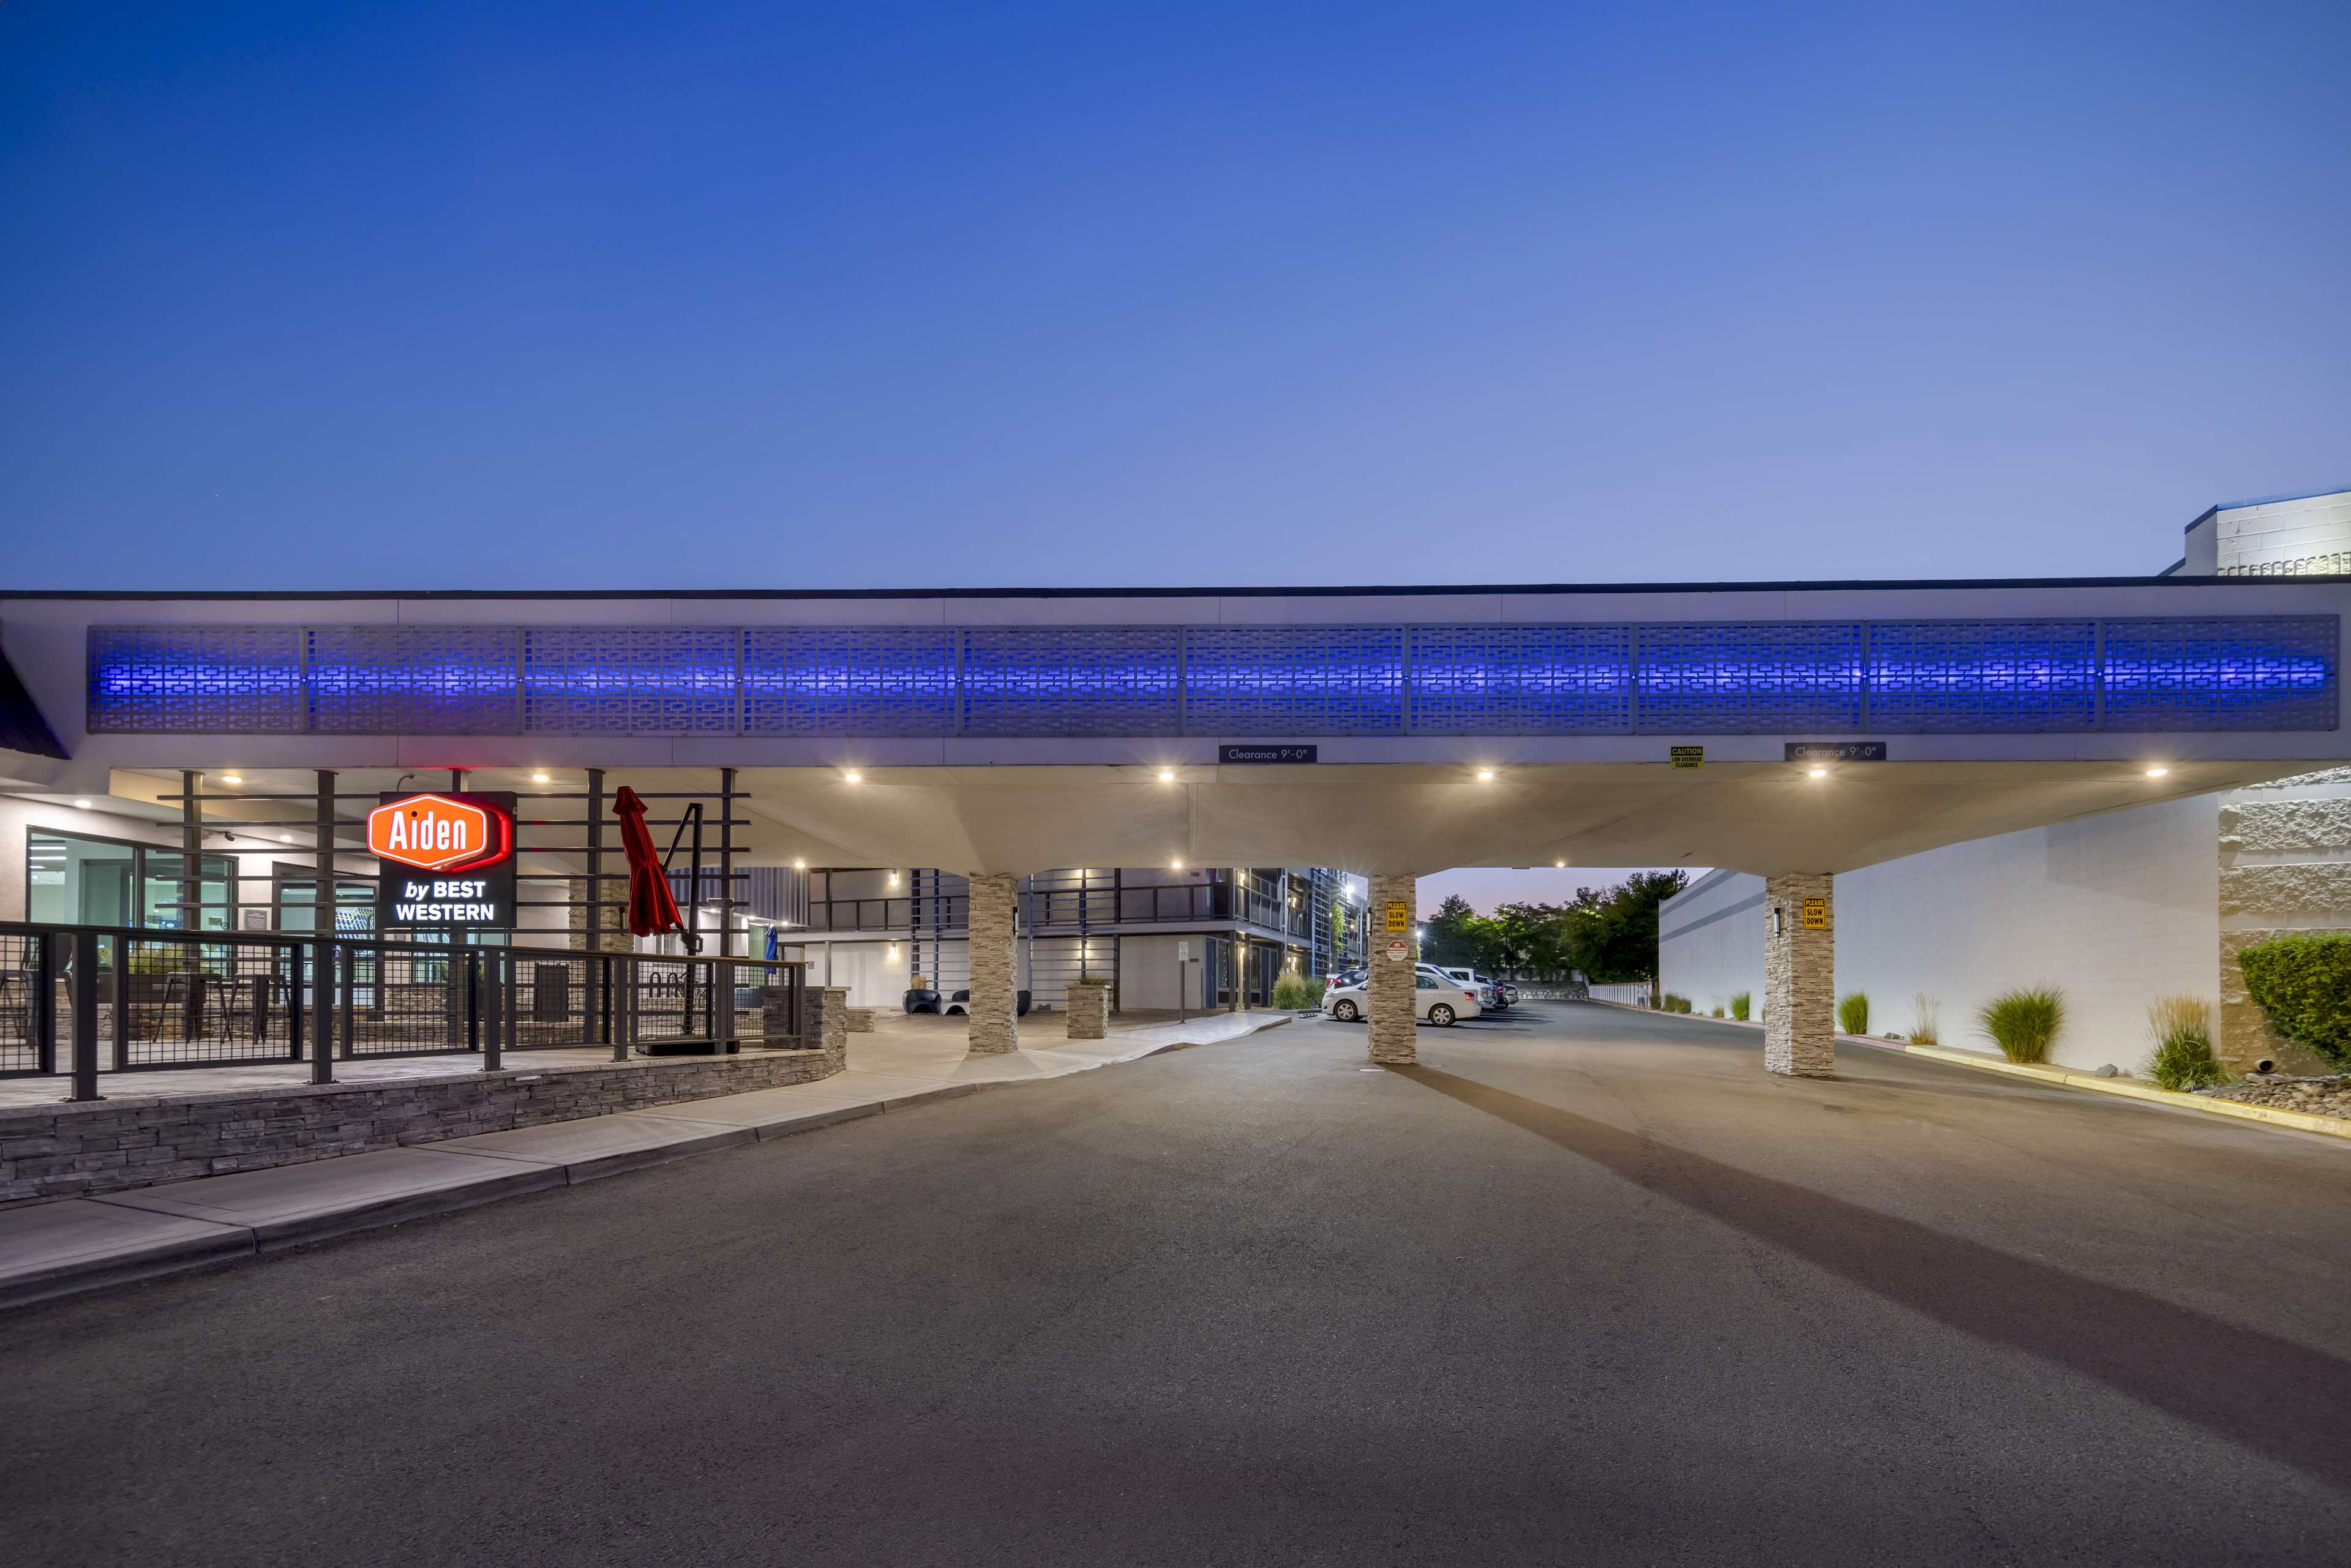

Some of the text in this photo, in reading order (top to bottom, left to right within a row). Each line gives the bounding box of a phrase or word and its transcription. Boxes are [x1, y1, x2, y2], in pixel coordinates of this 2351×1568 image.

[1229, 748, 1277, 759] Clearance
[1795, 746, 1845, 757] Clearance
[388, 811, 467, 850] Aiden
[405, 881, 486, 901] by BEST
[396, 904, 494, 920] WESTERN
